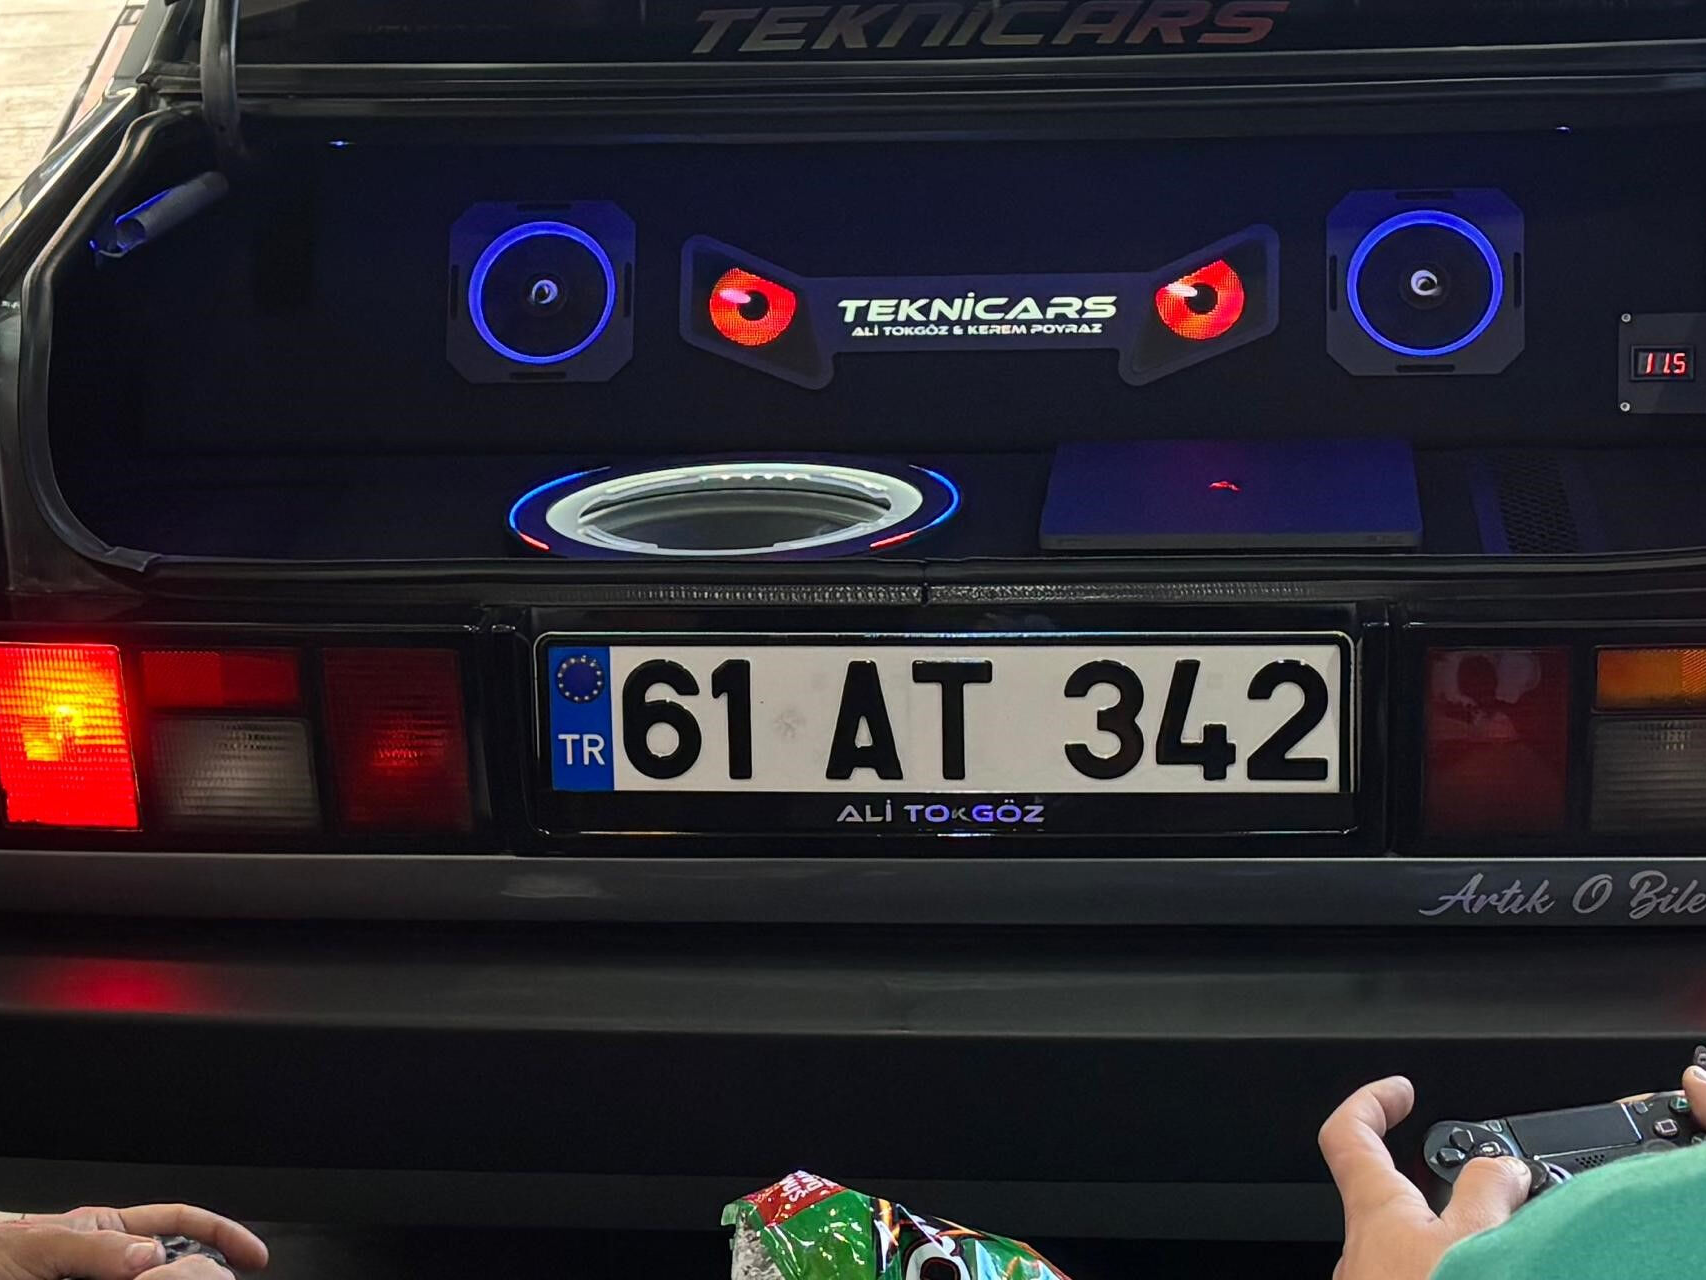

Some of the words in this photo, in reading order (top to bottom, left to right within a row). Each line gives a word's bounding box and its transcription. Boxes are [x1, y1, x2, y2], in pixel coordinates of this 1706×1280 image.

[837, 292, 1118, 323] TEKNİCARS
[851, 323, 879, 337] ALİ
[883, 324, 950, 336] TOKGÖZ
[953, 325, 964, 336] &
[968, 324, 1027, 336] KEREM
[1030, 323, 1103, 335] POYRAZ
[558, 733, 605, 766] TR
[620, 658, 754, 781] 61
[825, 659, 993, 781] AT
[1063, 658, 1330, 782] 342
[836, 799, 893, 823] ALİ
[1418, 871, 1556, 917] Artık
[1571, 872, 1614, 916] O
